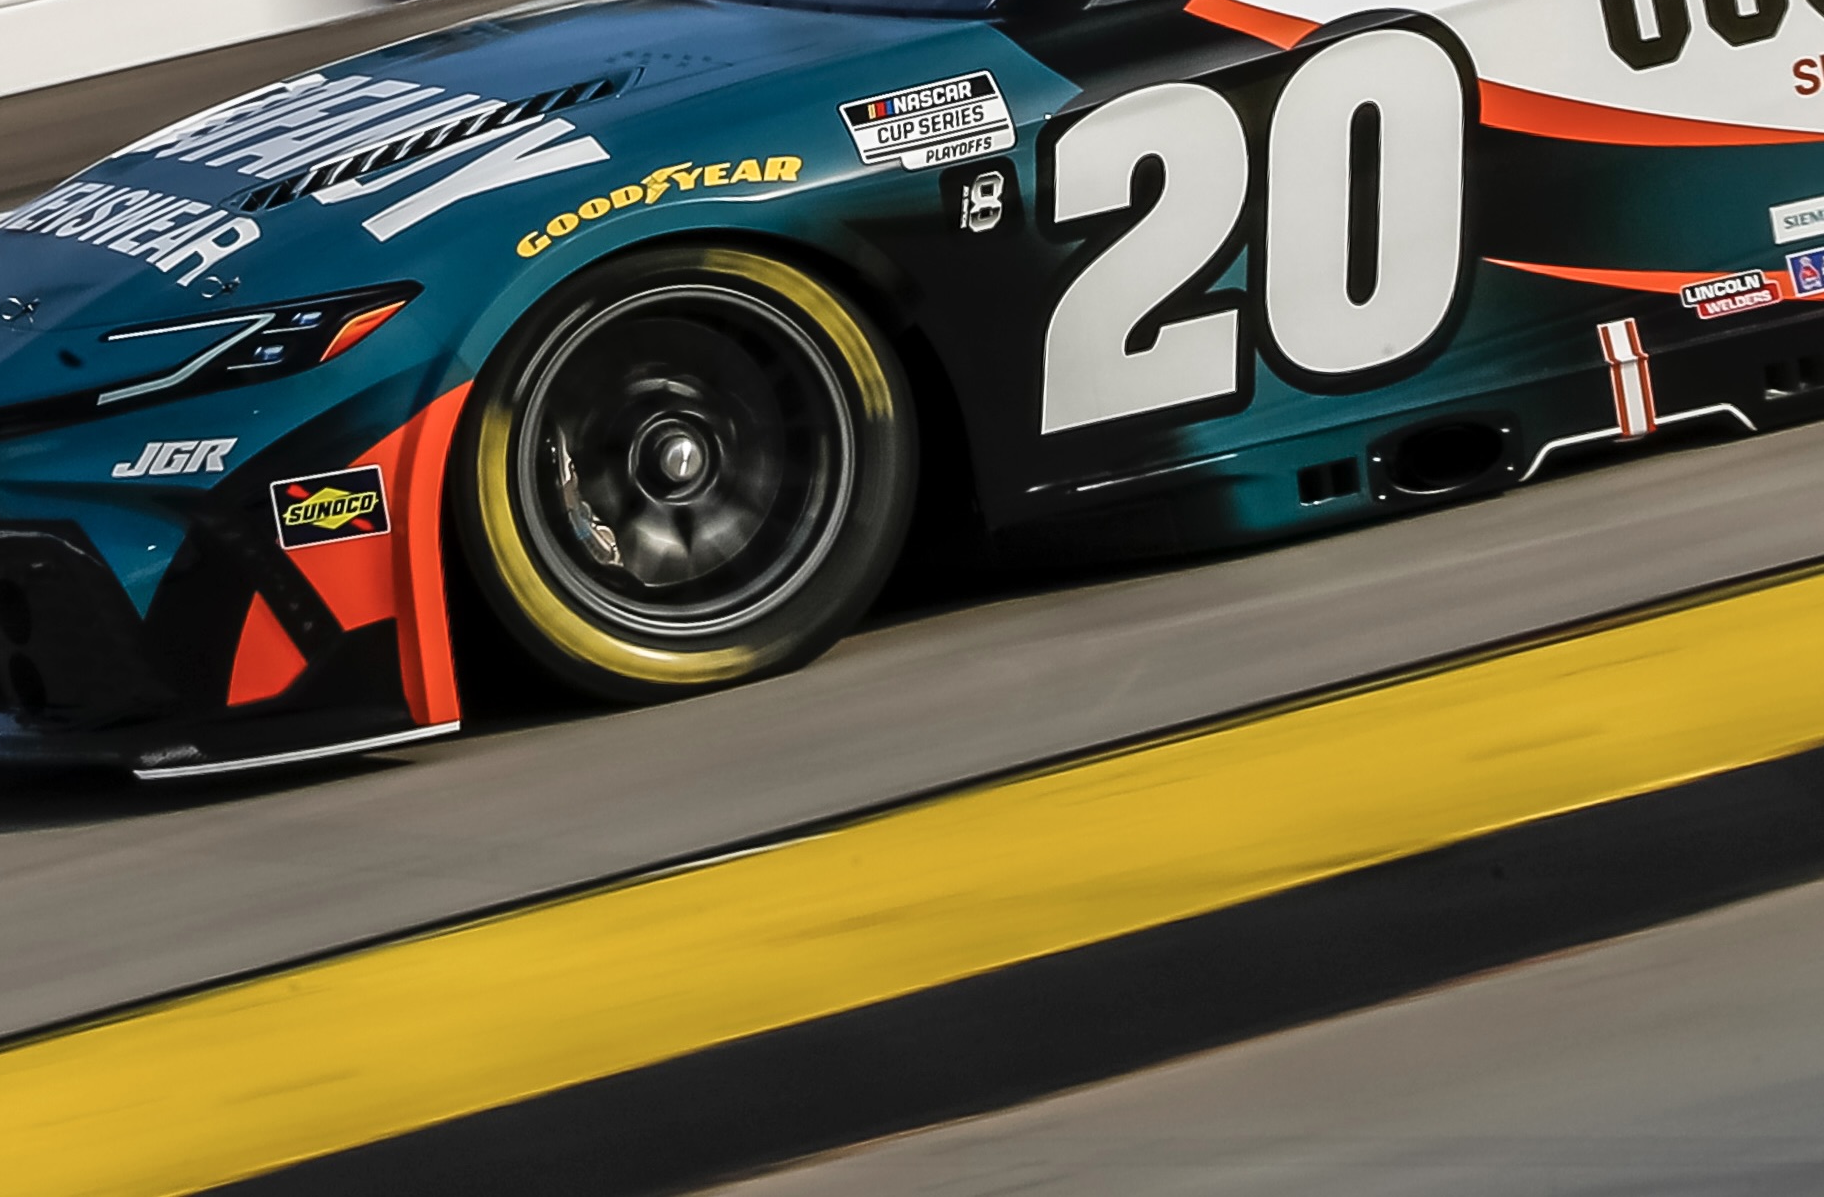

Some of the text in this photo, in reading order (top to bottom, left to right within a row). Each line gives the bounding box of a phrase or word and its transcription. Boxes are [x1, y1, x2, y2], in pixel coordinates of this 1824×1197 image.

[892, 81, 973, 115] NASCAR
[877, 105, 985, 144] CUP SERIES
[926, 136, 992, 164] PLAYOFFS
[516, 155, 803, 258] GOODYEAR
[969, 171, 1005, 233] 8
[1040, 28, 1465, 436] 20
[1685, 274, 1761, 303] LINCOLN
[1704, 289, 1773, 314] WELDERS
[111, 437, 239, 478] JGR
[288, 492, 376, 523] SUNOCO
